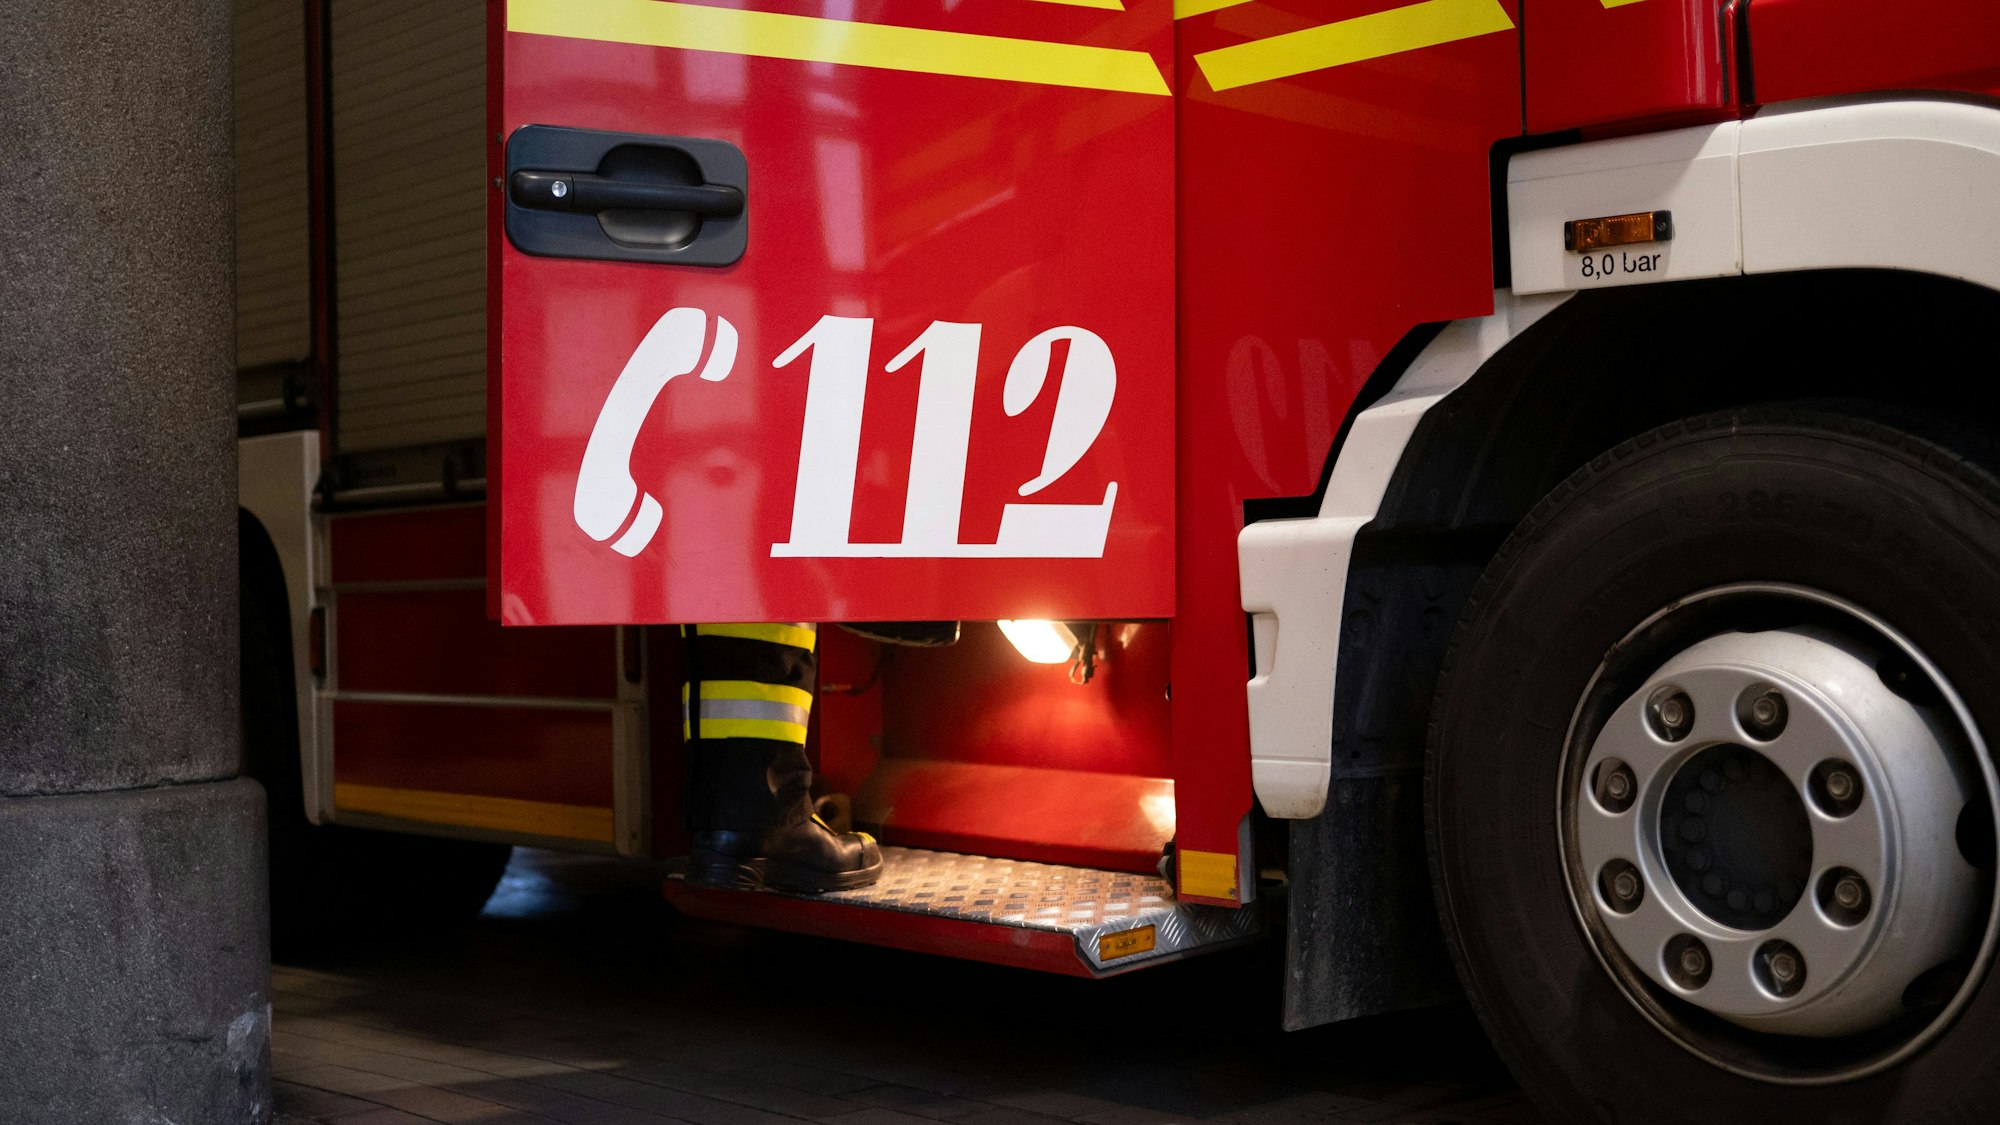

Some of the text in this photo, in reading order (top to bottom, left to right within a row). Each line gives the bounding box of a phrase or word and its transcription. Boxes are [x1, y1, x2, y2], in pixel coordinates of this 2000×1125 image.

[1582, 251, 1661, 280] 8,0 bar
[770, 315, 1119, 558] 112
